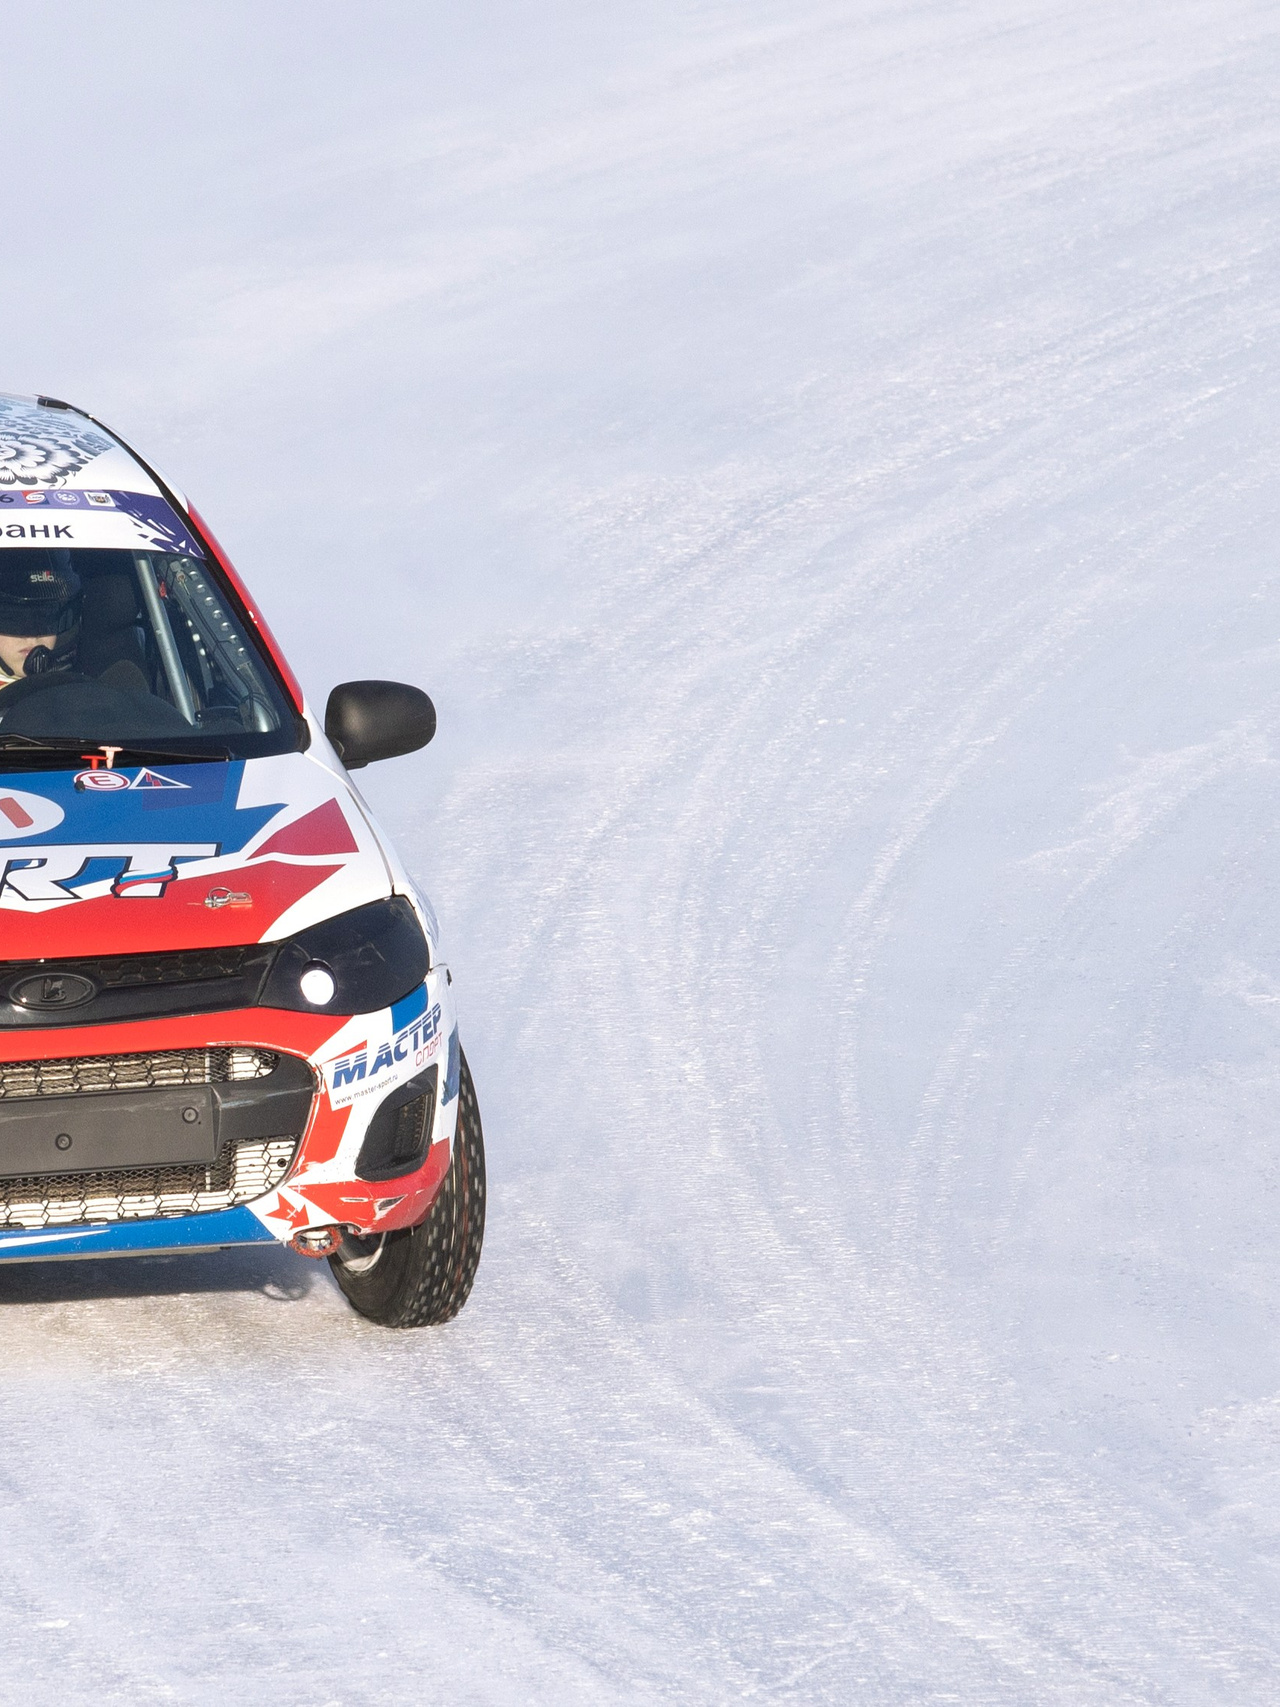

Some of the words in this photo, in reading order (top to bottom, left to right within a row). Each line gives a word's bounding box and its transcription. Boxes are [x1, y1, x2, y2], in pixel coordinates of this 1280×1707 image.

[333, 1002, 441, 1089] МАСТЕР
[415, 1032, 442, 1067] СПОРТ
[334, 1073, 398, 1106] www.master-sport.ru
